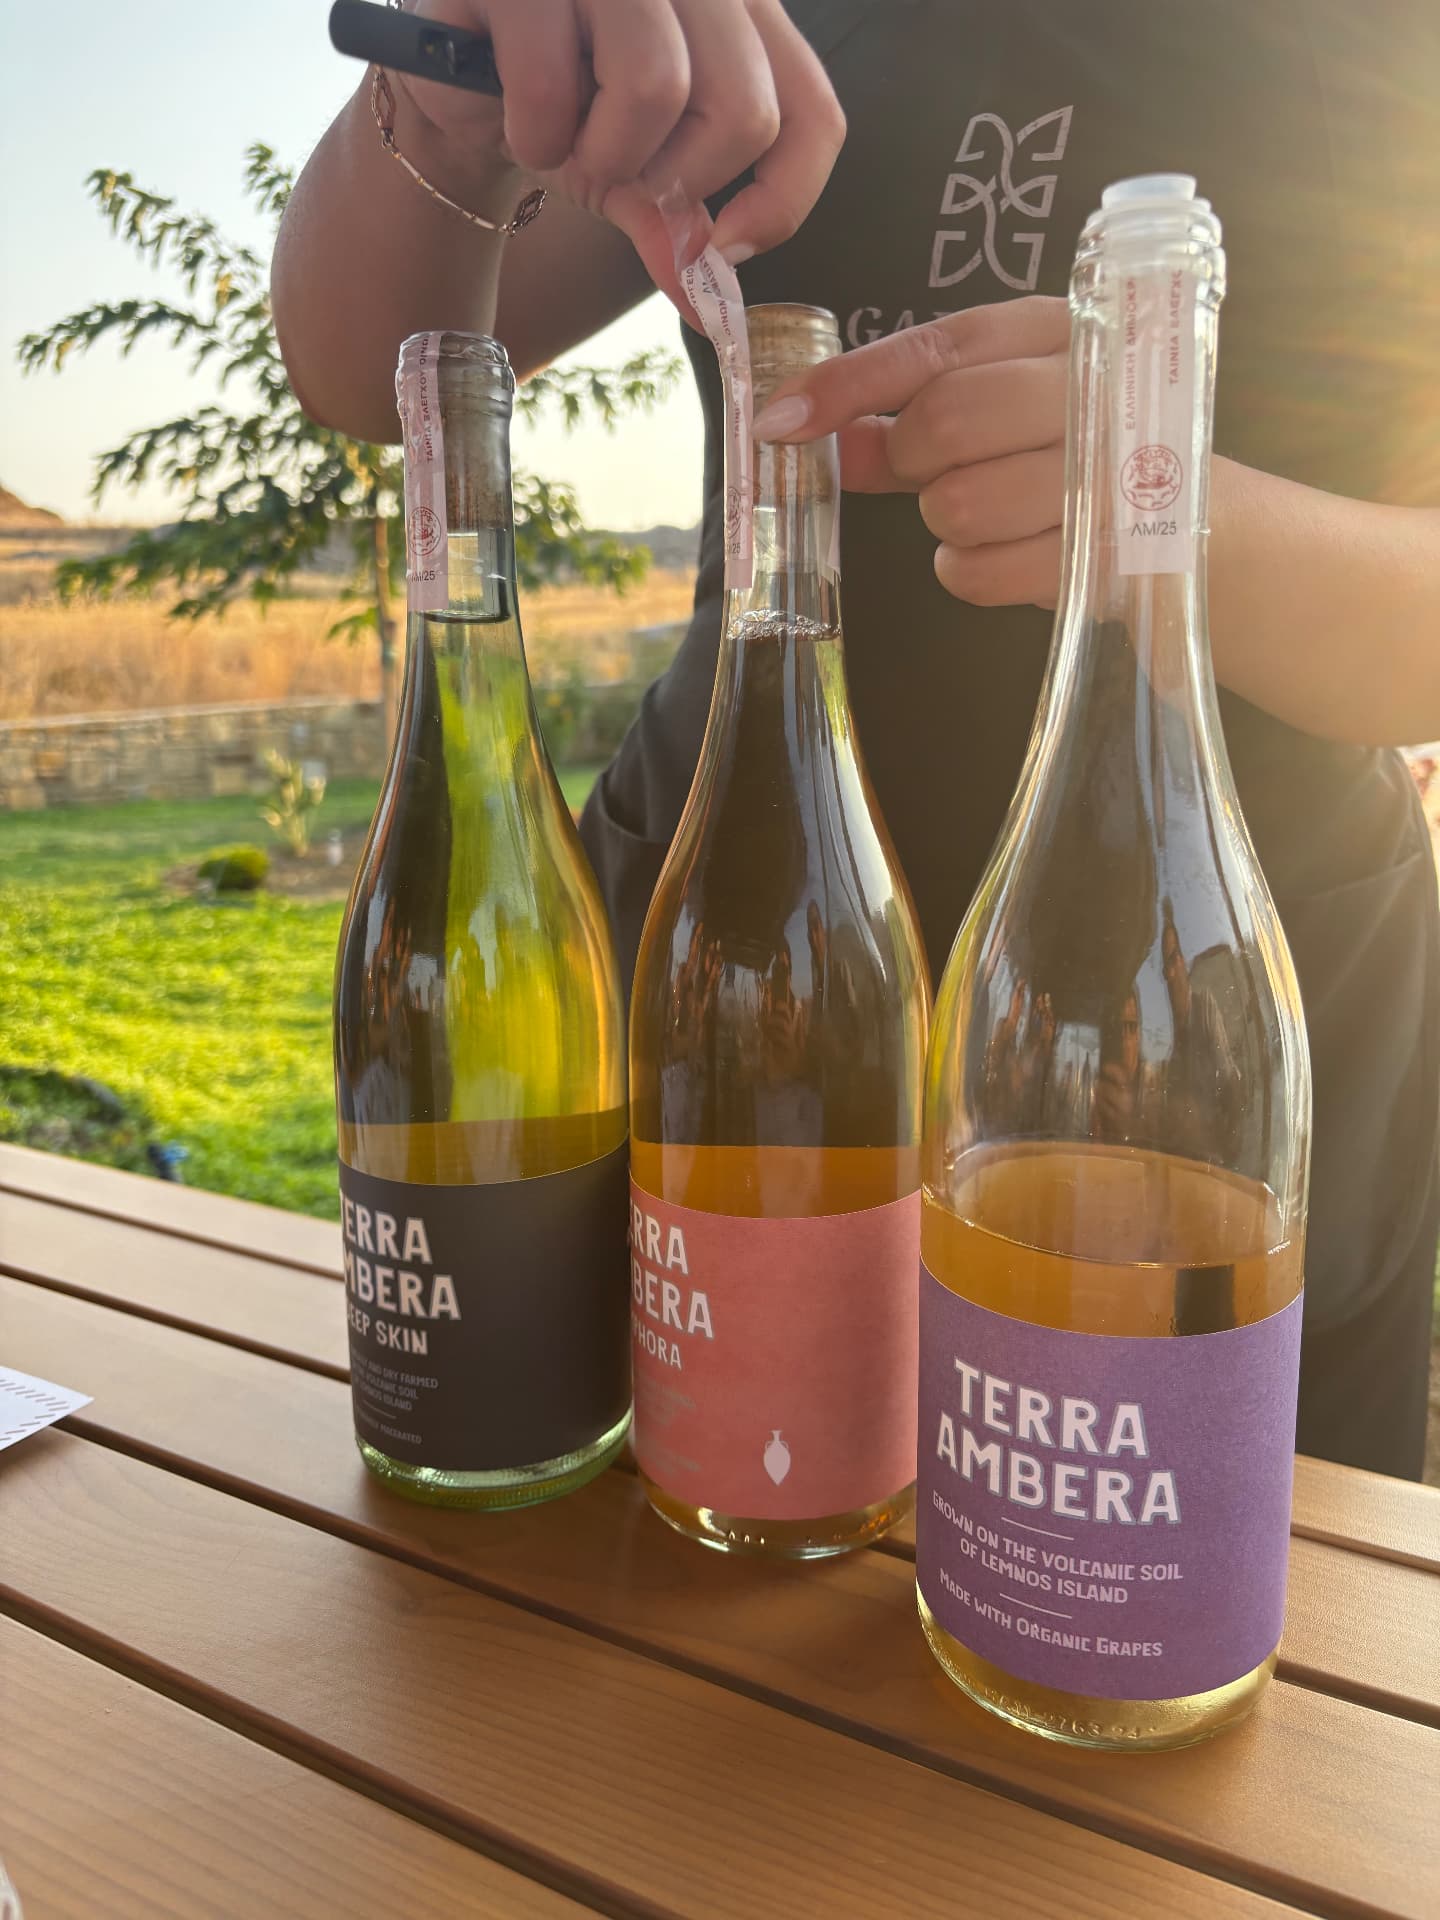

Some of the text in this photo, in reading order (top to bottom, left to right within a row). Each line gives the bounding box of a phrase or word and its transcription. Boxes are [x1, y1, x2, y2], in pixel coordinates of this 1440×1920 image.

[1124, 351, 1137, 430] ΕΛΛΗΝΙΚΗ
[1168, 334, 1180, 387] ΤΑΙΝΙΑ
[343, 1196, 432, 1264] ERRA
[631, 1202, 689, 1276] RRA
[350, 1303, 428, 1355] EEP SKIN
[632, 1257, 715, 1340] BERA
[398, 1385, 418, 1399] SOIL
[400, 1372, 439, 1389] FARMED
[953, 1356, 1150, 1459] TERRA
[936, 1410, 1183, 1526] AMBERA
[932, 1489, 1183, 1582] GROWN ON THE VOLCANIC SOIL
[960, 1538, 1129, 1604] OF LEMNOS ISLAND
